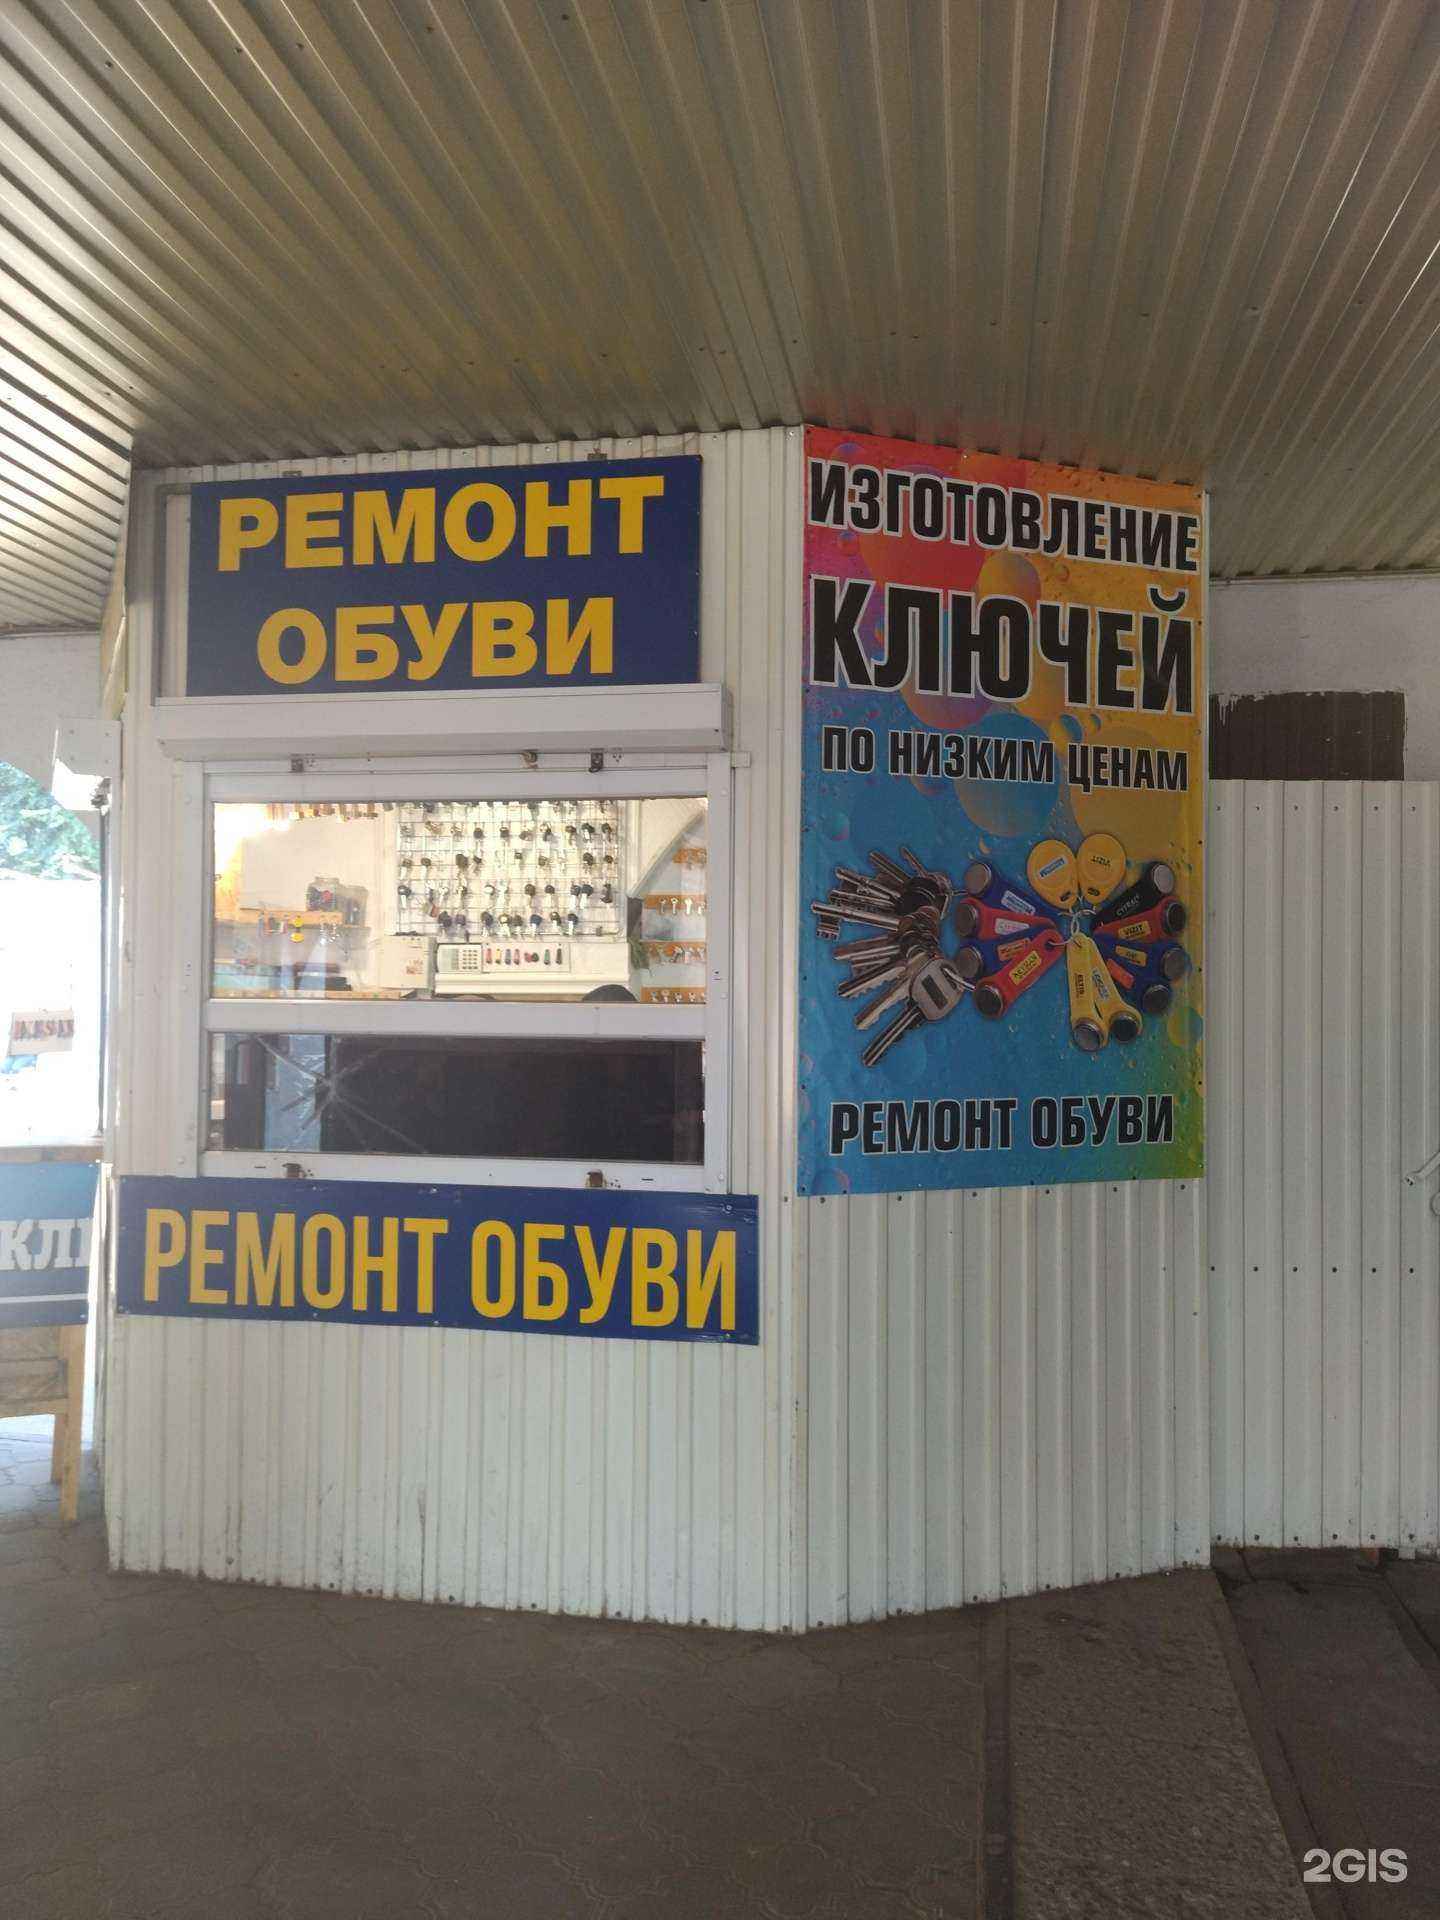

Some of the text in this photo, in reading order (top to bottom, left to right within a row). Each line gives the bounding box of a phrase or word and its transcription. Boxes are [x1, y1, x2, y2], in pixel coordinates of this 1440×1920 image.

[218, 475, 665, 571] РЕМОНТ
[807, 457, 1200, 574] ИЗГОТОВЛЕНИЕ
[257, 597, 614, 684] ОБУВИ
[809, 574, 1195, 716] КЛЮЧЕЙ
[821, 725, 1189, 795] ПО НИЗКИМ ЦЕНАМ
[829, 1095, 1175, 1156] РЕМОНТ ОБУВИ
[143, 1208, 737, 1330] РЕМОНТ ОБУВИ
